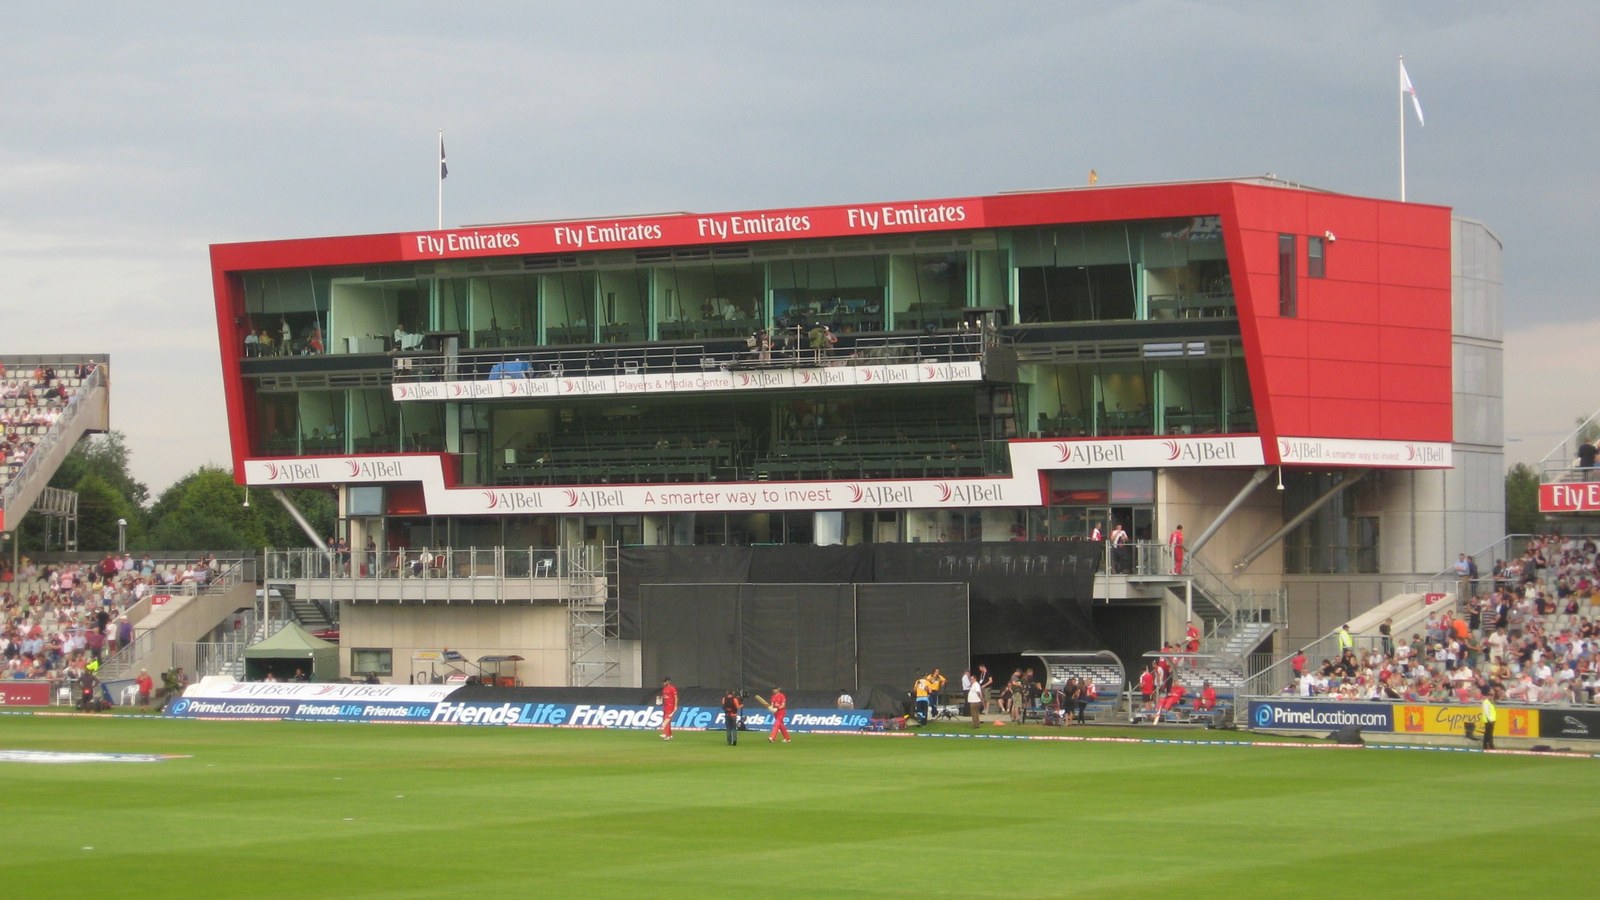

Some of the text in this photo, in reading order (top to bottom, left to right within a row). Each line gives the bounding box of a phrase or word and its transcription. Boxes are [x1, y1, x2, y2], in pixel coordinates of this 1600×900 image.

[697, 214, 811, 239] Fly Emirates
[847, 205, 966, 230] Fly Emirates
[416, 231, 520, 255] Fly Emirates
[554, 224, 662, 247] Fly Emirates
[619, 377, 729, 393] Players & Media Centre
[644, 487, 832, 506] A smarter way to invest
[1553, 485, 1583, 510] Fly
[188, 701, 290, 715] PrimeLocation.com
[1274, 707, 1387, 726] PrimeLocation.com
[1436, 707, 1483, 732] Cyprus
